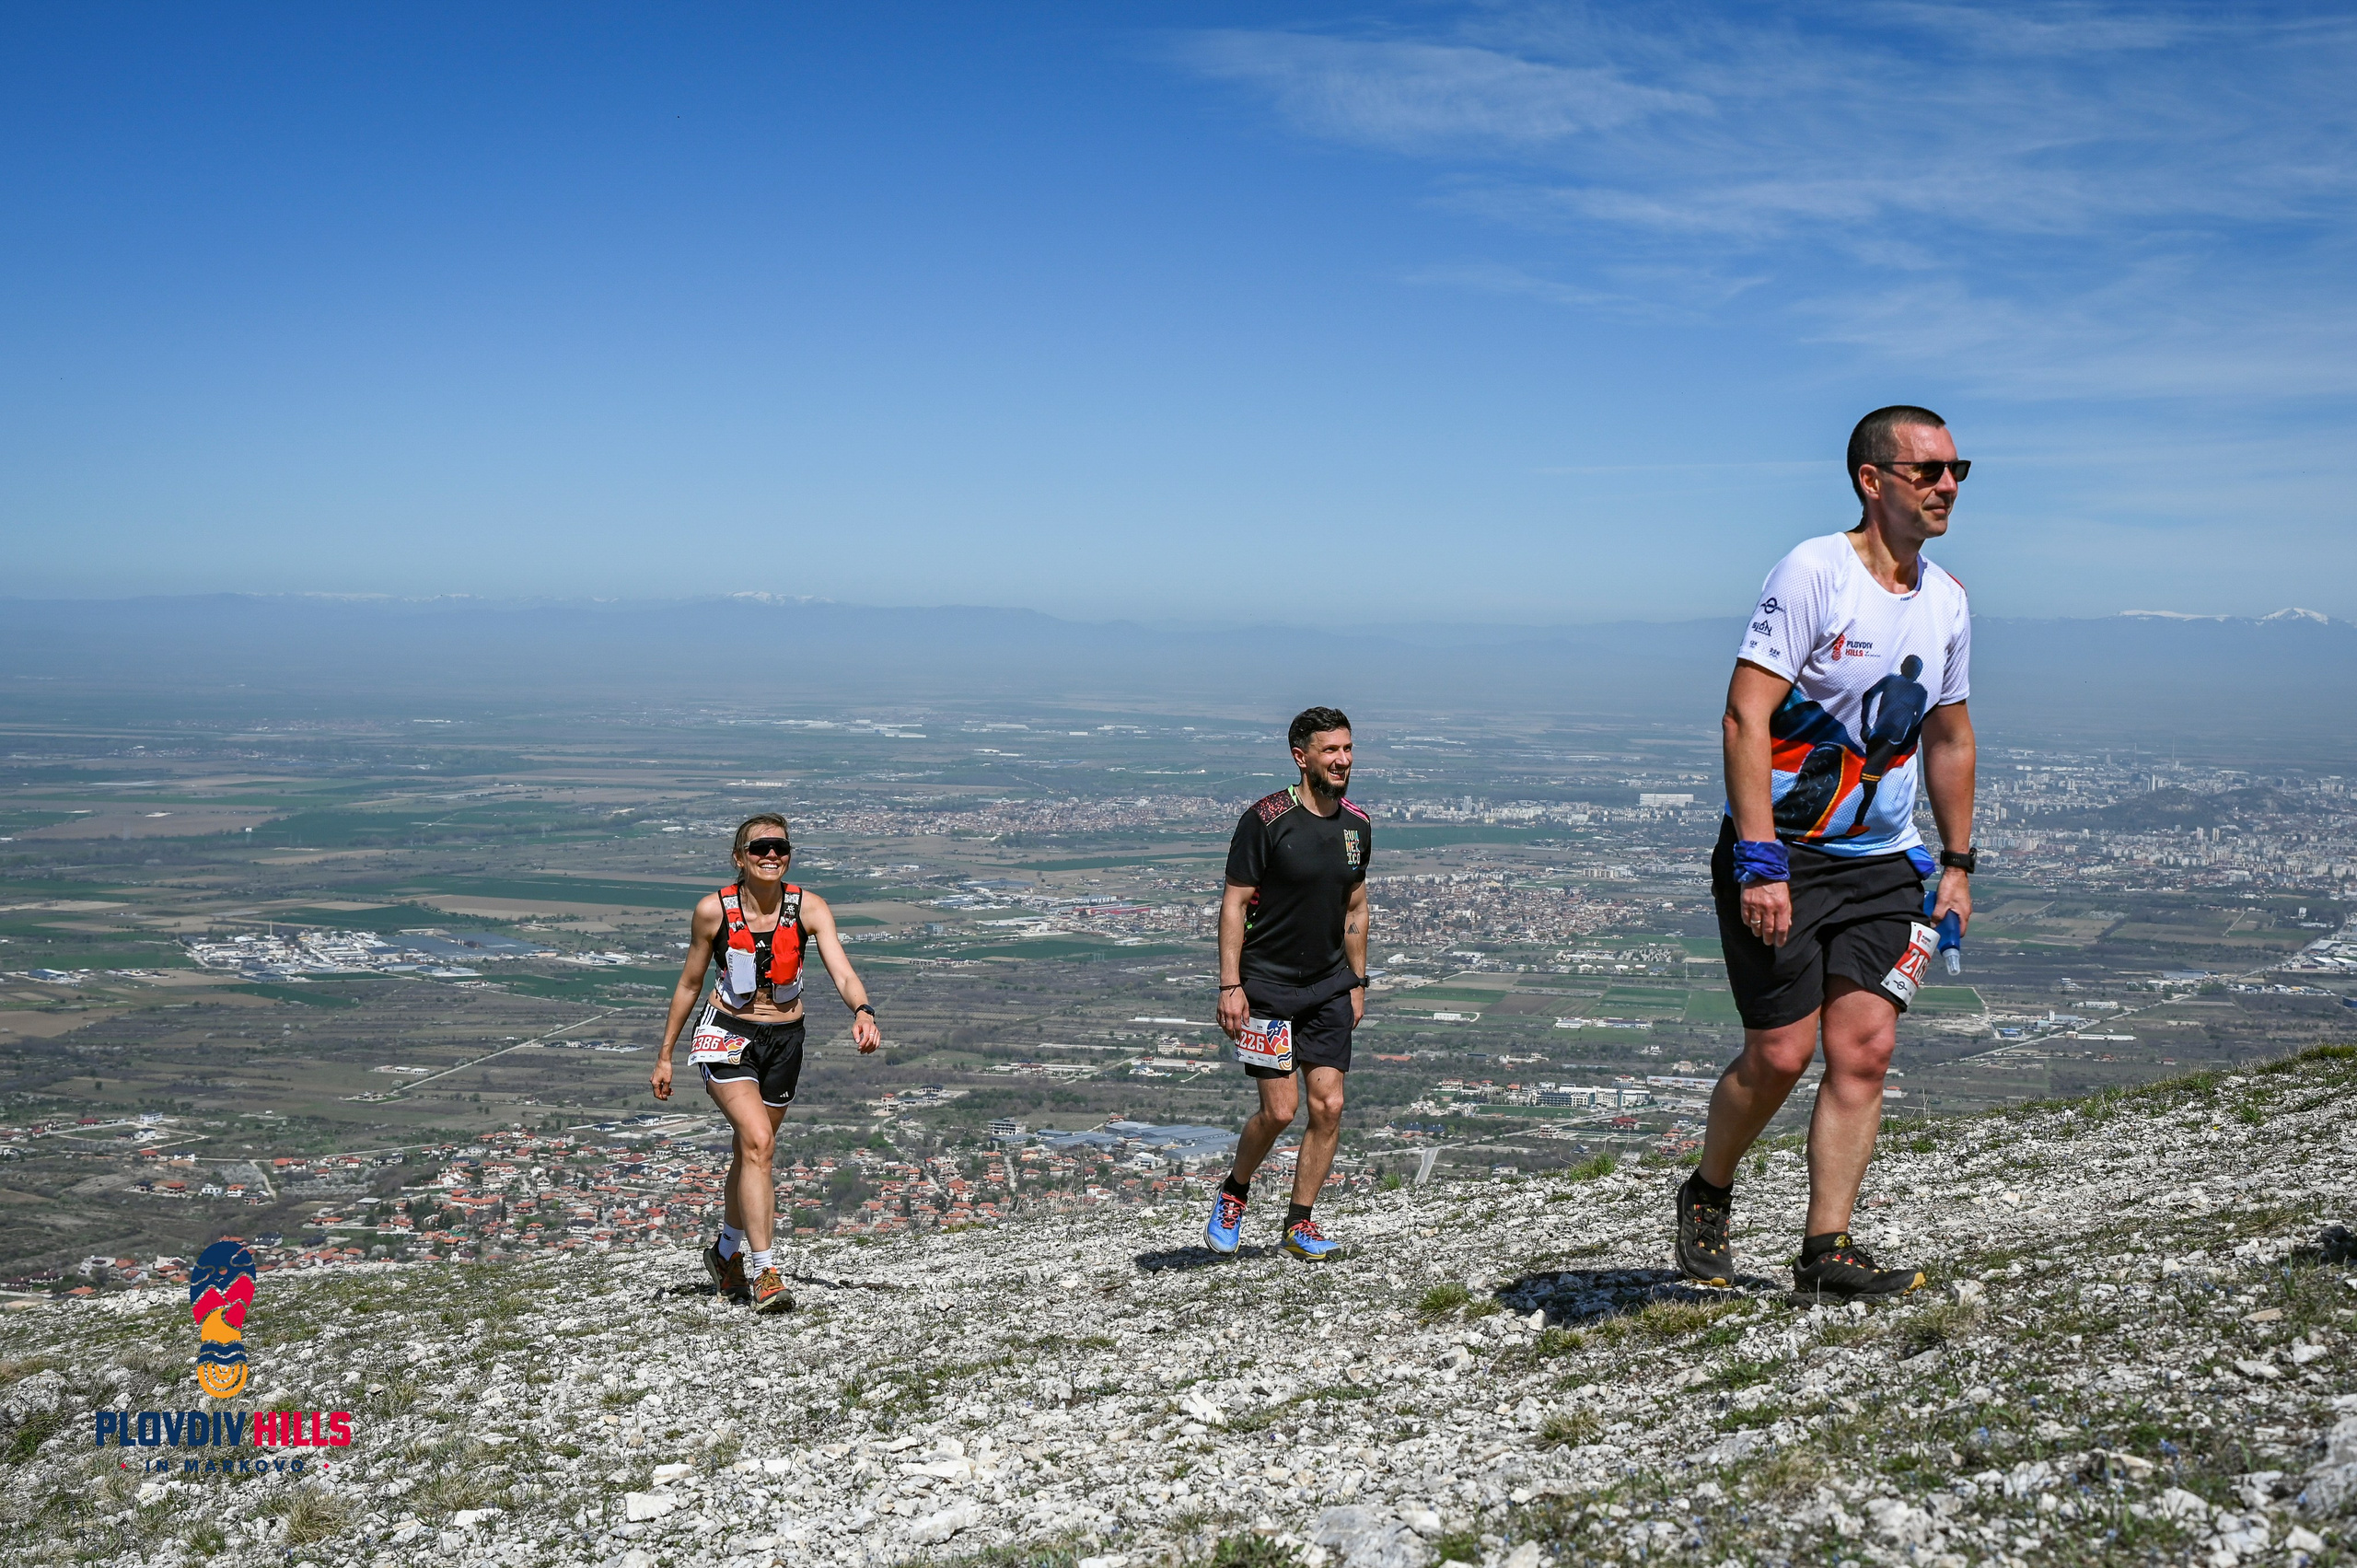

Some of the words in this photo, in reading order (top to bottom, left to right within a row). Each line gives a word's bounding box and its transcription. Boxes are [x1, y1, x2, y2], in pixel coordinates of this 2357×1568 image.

[1846, 641, 1873, 649] PLOVDIV
[1845, 648, 1864, 656] HILLS
[691, 1036, 721, 1051] 2386
